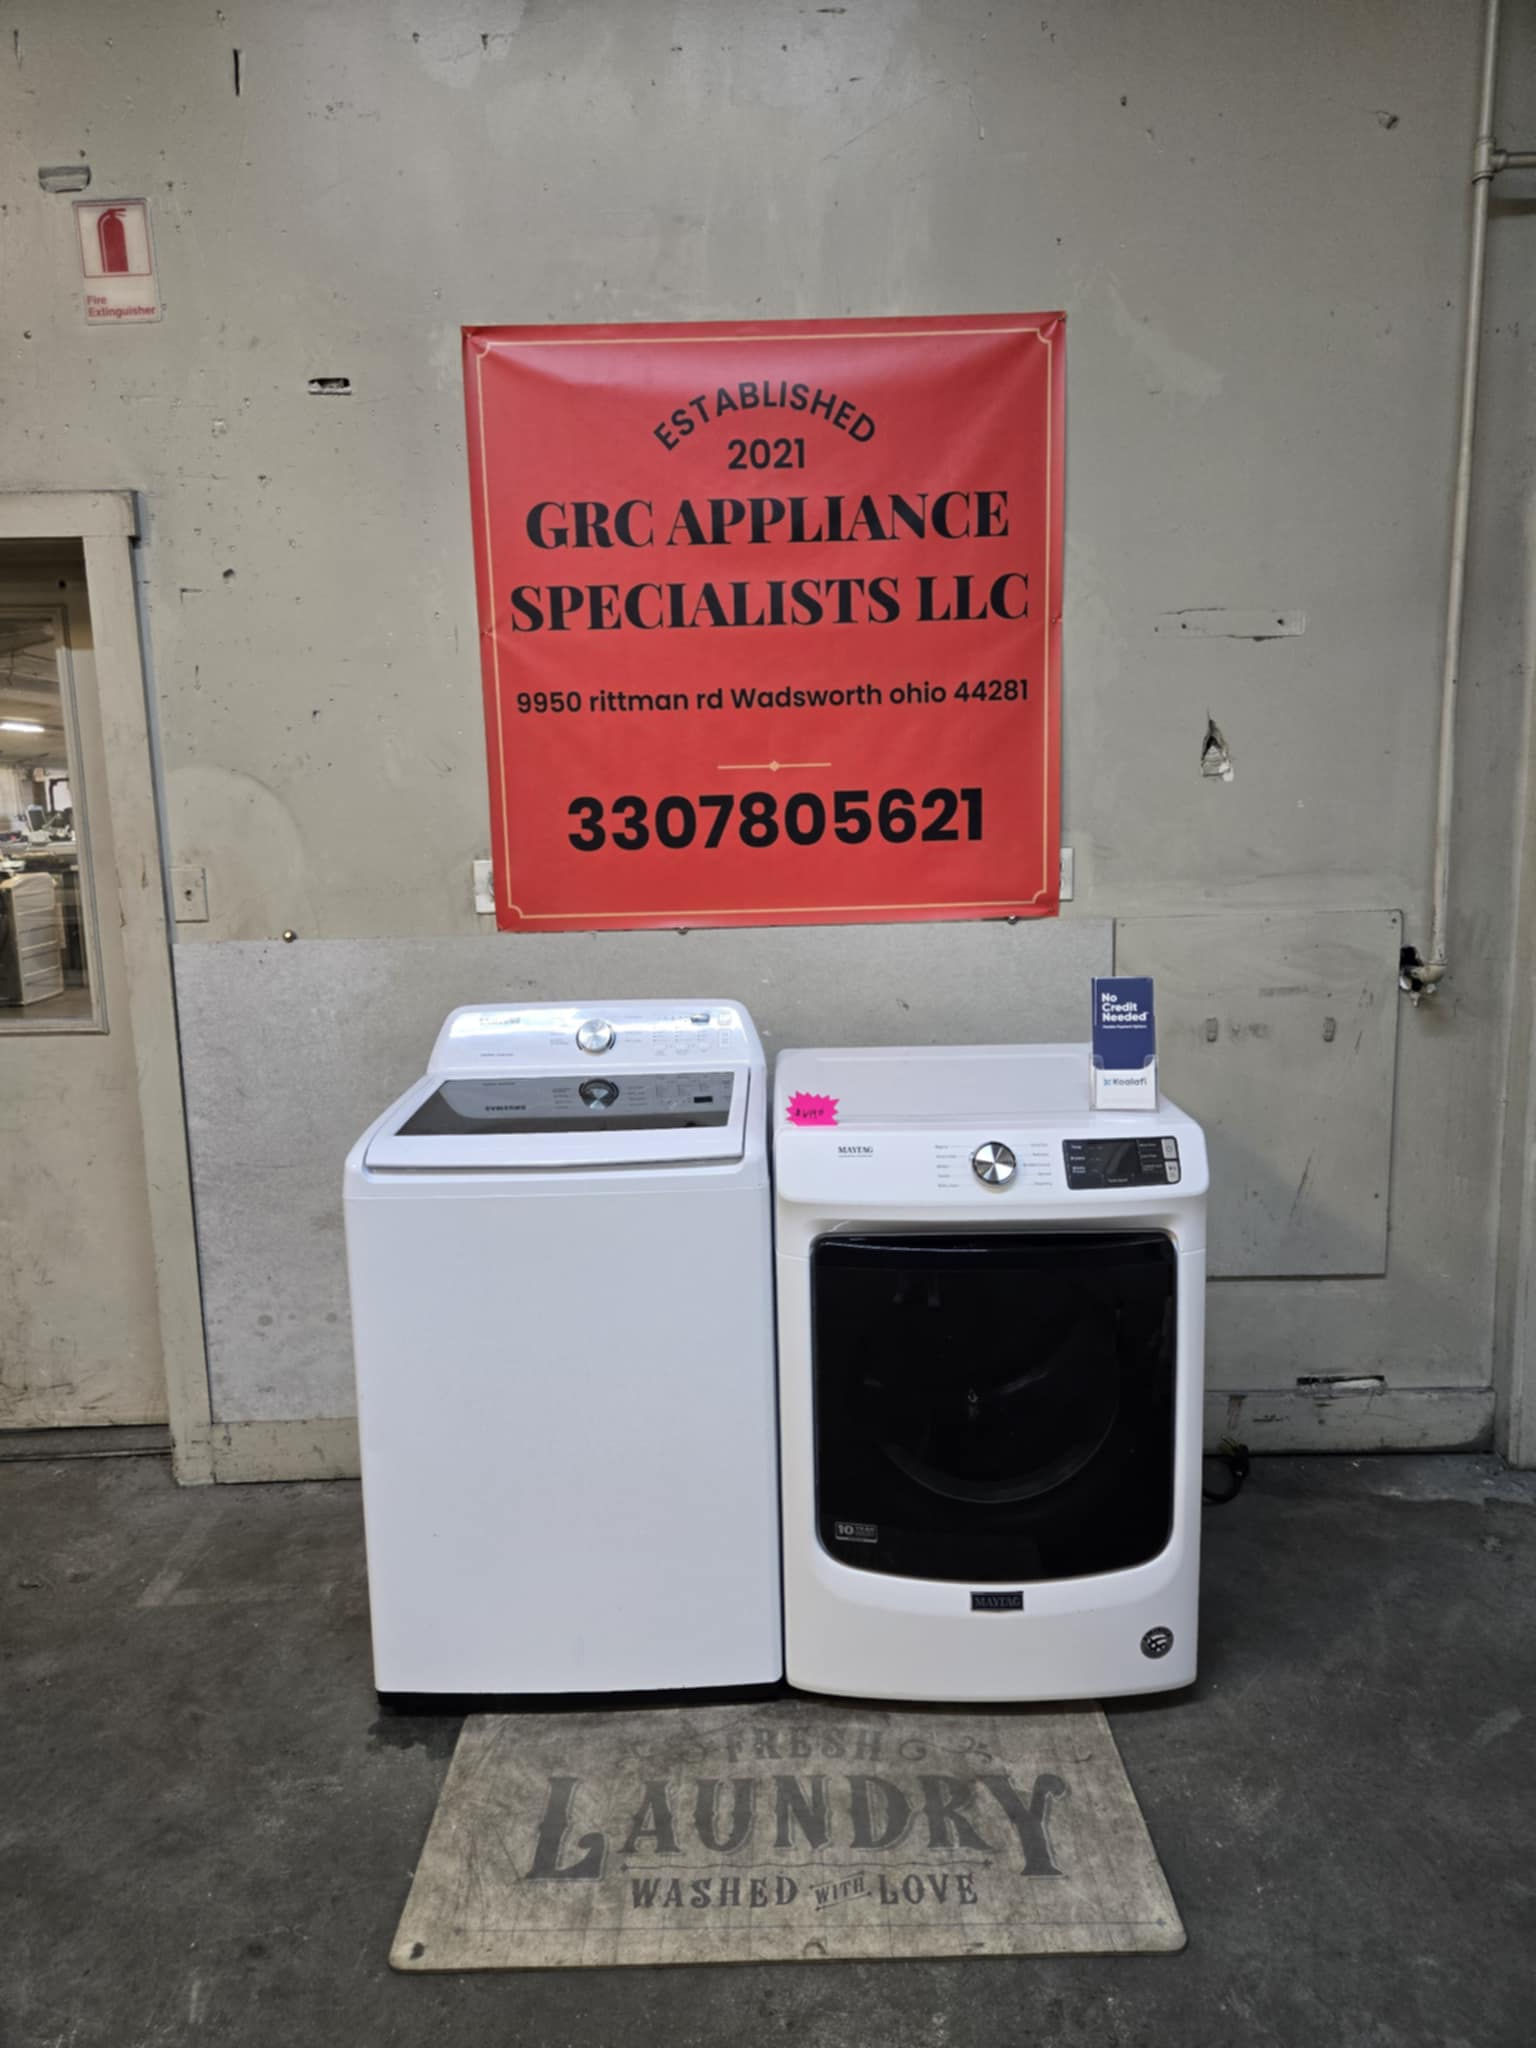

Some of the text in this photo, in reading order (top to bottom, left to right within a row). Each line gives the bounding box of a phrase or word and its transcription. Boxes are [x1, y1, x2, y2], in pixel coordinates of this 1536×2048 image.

[86, 295, 107, 305] Fire
[87, 306, 156, 318] Extinguisher
[653, 380, 876, 451] ESTABLISHED
[727, 438, 806, 470] 2021
[525, 490, 1010, 549] GRC APPLIANCE
[510, 573, 1030, 633] SPECIALISTS LLC
[516, 679, 1029, 714] 9950 rittman rd Wadsworth ohio 44281
[567, 786, 983, 852] 3307805621
[1101, 992, 1118, 1003] No
[1102, 1002, 1138, 1012] Credit
[837, 1145, 874, 1154] MAYTAG
[838, 1524, 854, 1535] 10
[726, 1726, 884, 1763] FRESH
[525, 1773, 1072, 1881] LAUNDRY
[631, 1873, 977, 1910] WASHED WITH LOVE
